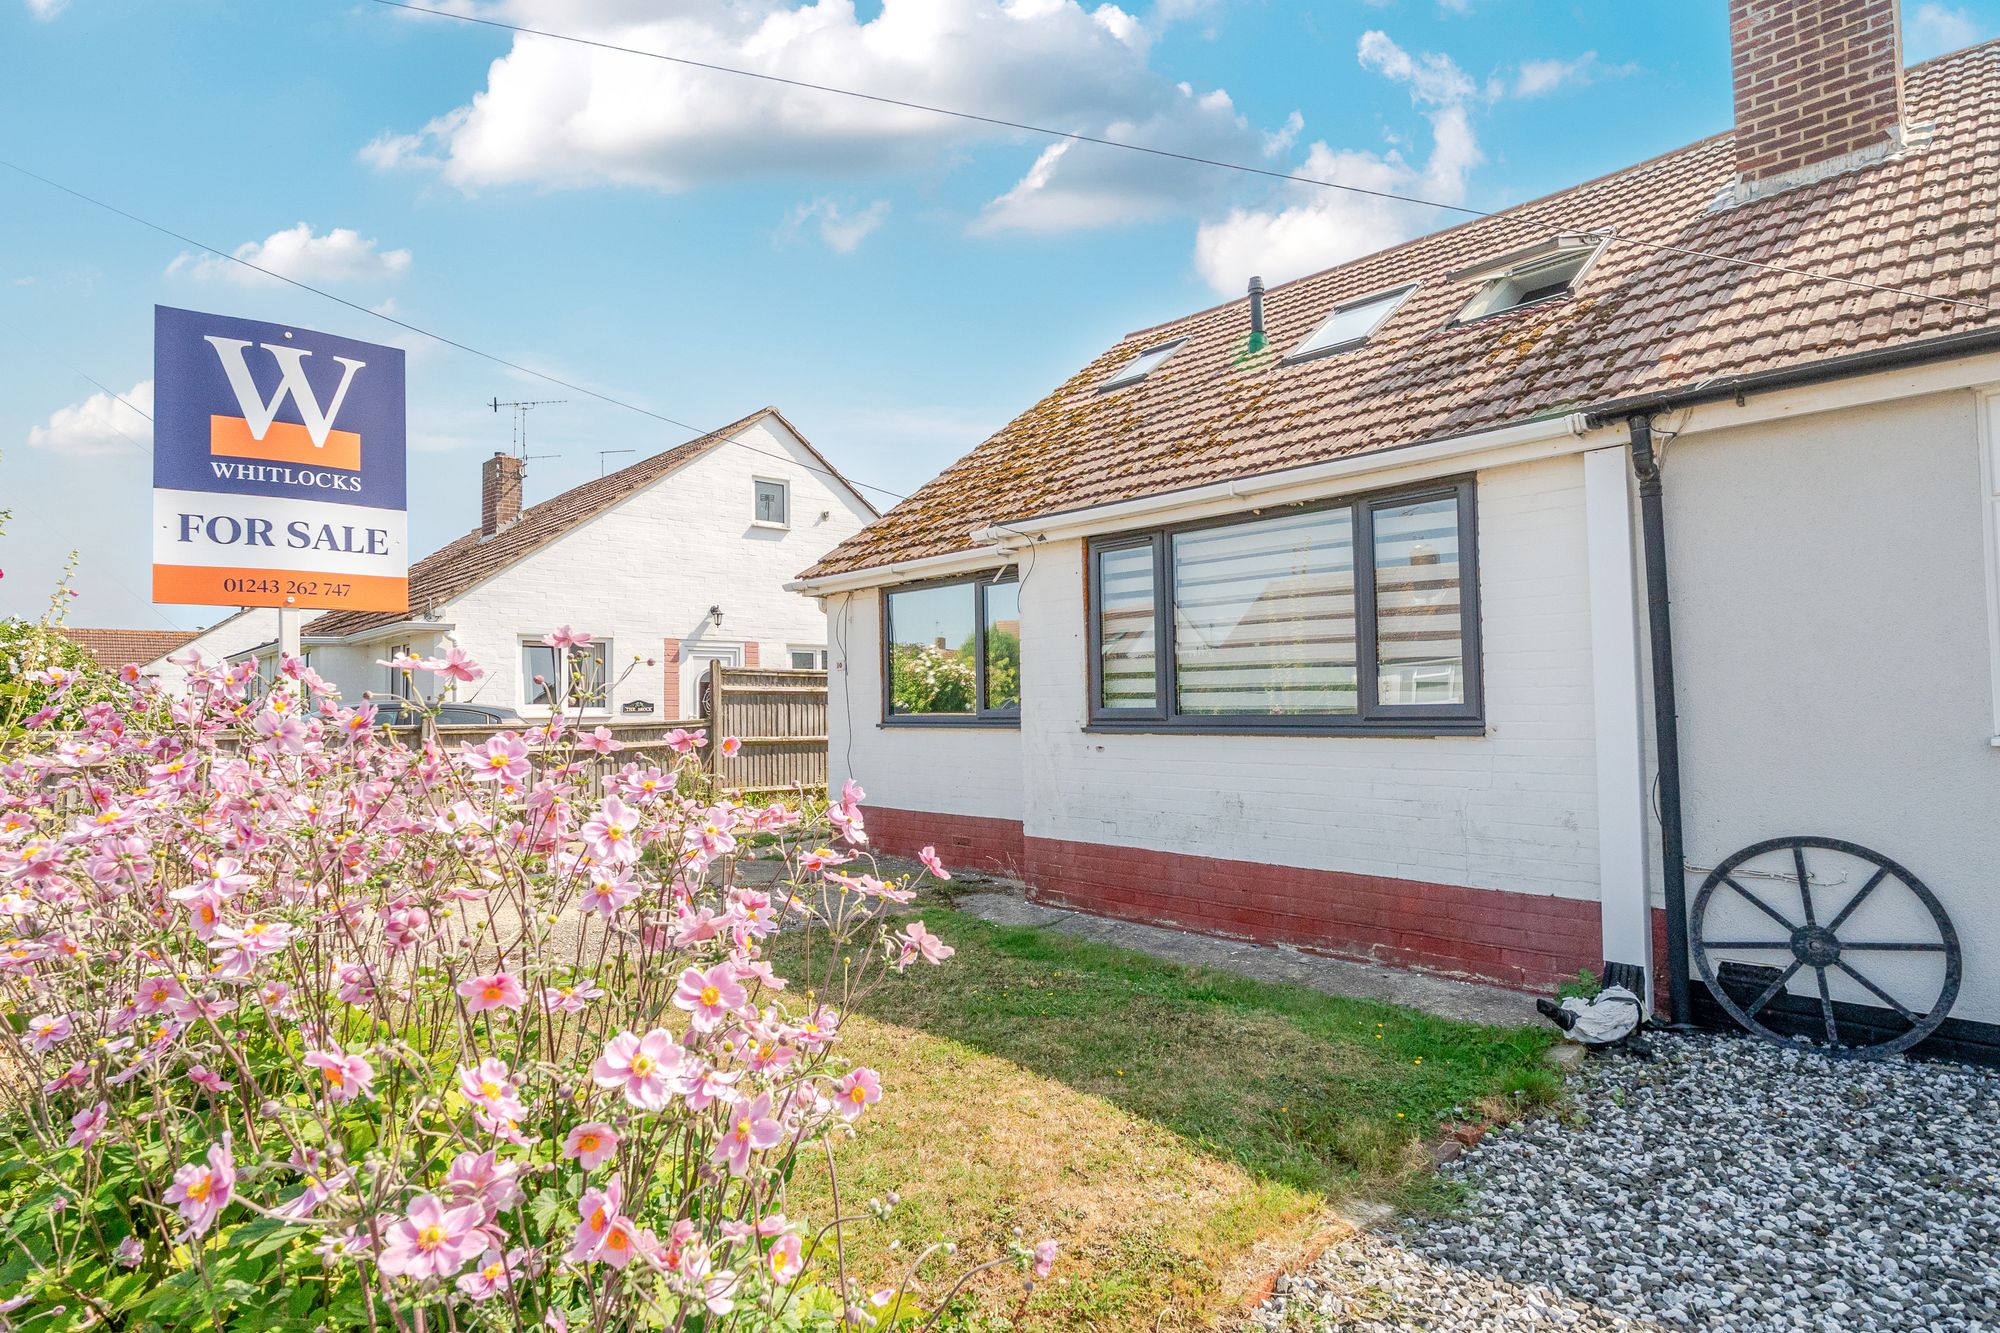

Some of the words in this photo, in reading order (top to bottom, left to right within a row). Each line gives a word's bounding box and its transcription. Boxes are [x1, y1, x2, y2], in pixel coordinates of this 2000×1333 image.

[204, 335, 366, 448] W
[210, 461, 362, 492] WHITLOCKS
[177, 513, 275, 547] FOR
[287, 521, 389, 556] SALE
[223, 578, 280, 594] 01243
[286, 580, 318, 596] 262
[323, 582, 351, 597] 747
